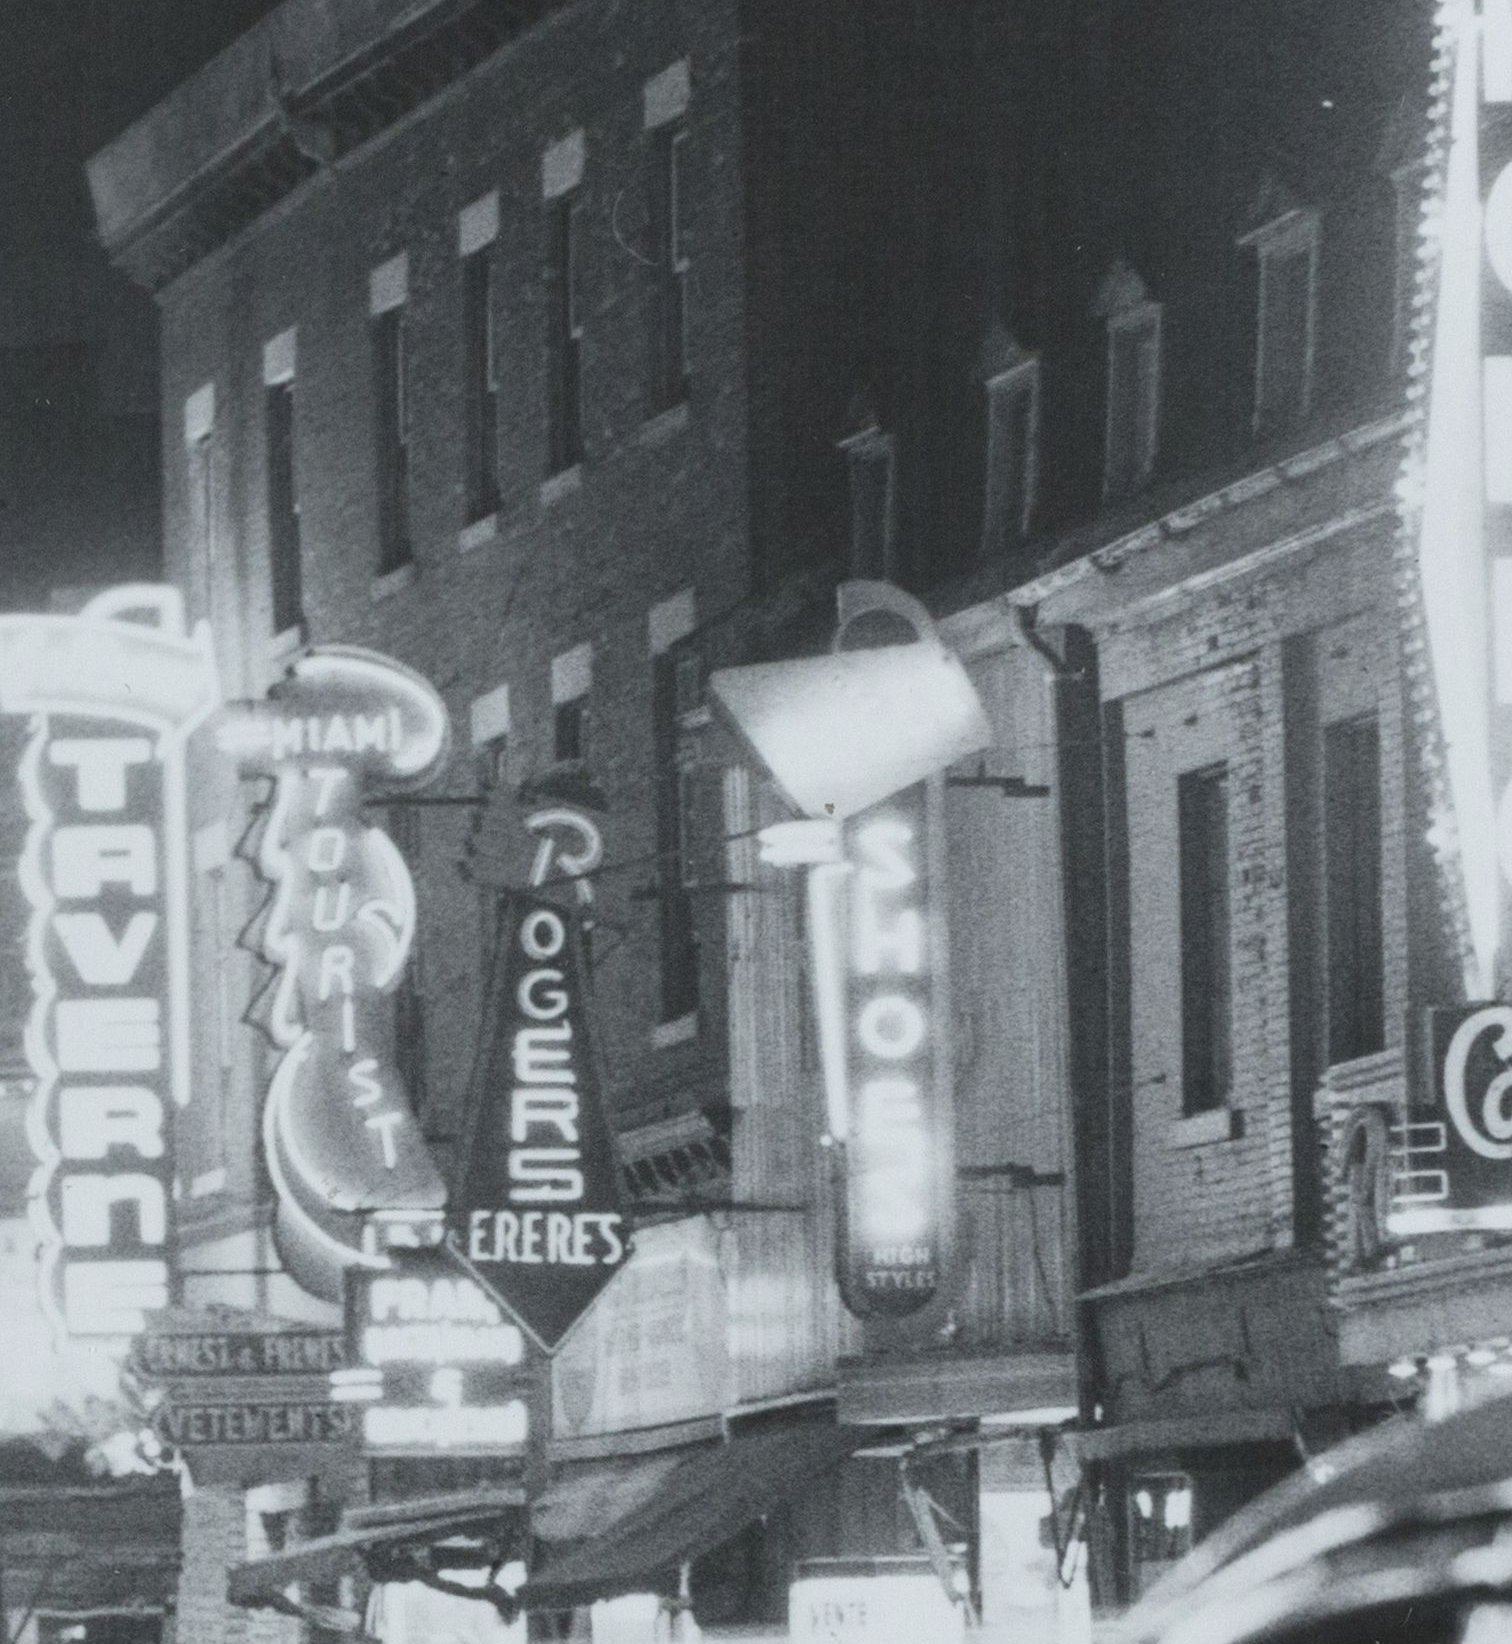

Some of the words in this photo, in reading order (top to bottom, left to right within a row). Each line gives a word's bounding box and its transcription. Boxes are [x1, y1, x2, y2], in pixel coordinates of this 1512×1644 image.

[273, 707, 400, 759] MIAMI
[49, 739, 170, 1334] TAVERNE
[308, 768, 405, 1169] TOURIST
[510, 808, 602, 1203] ROGERS
